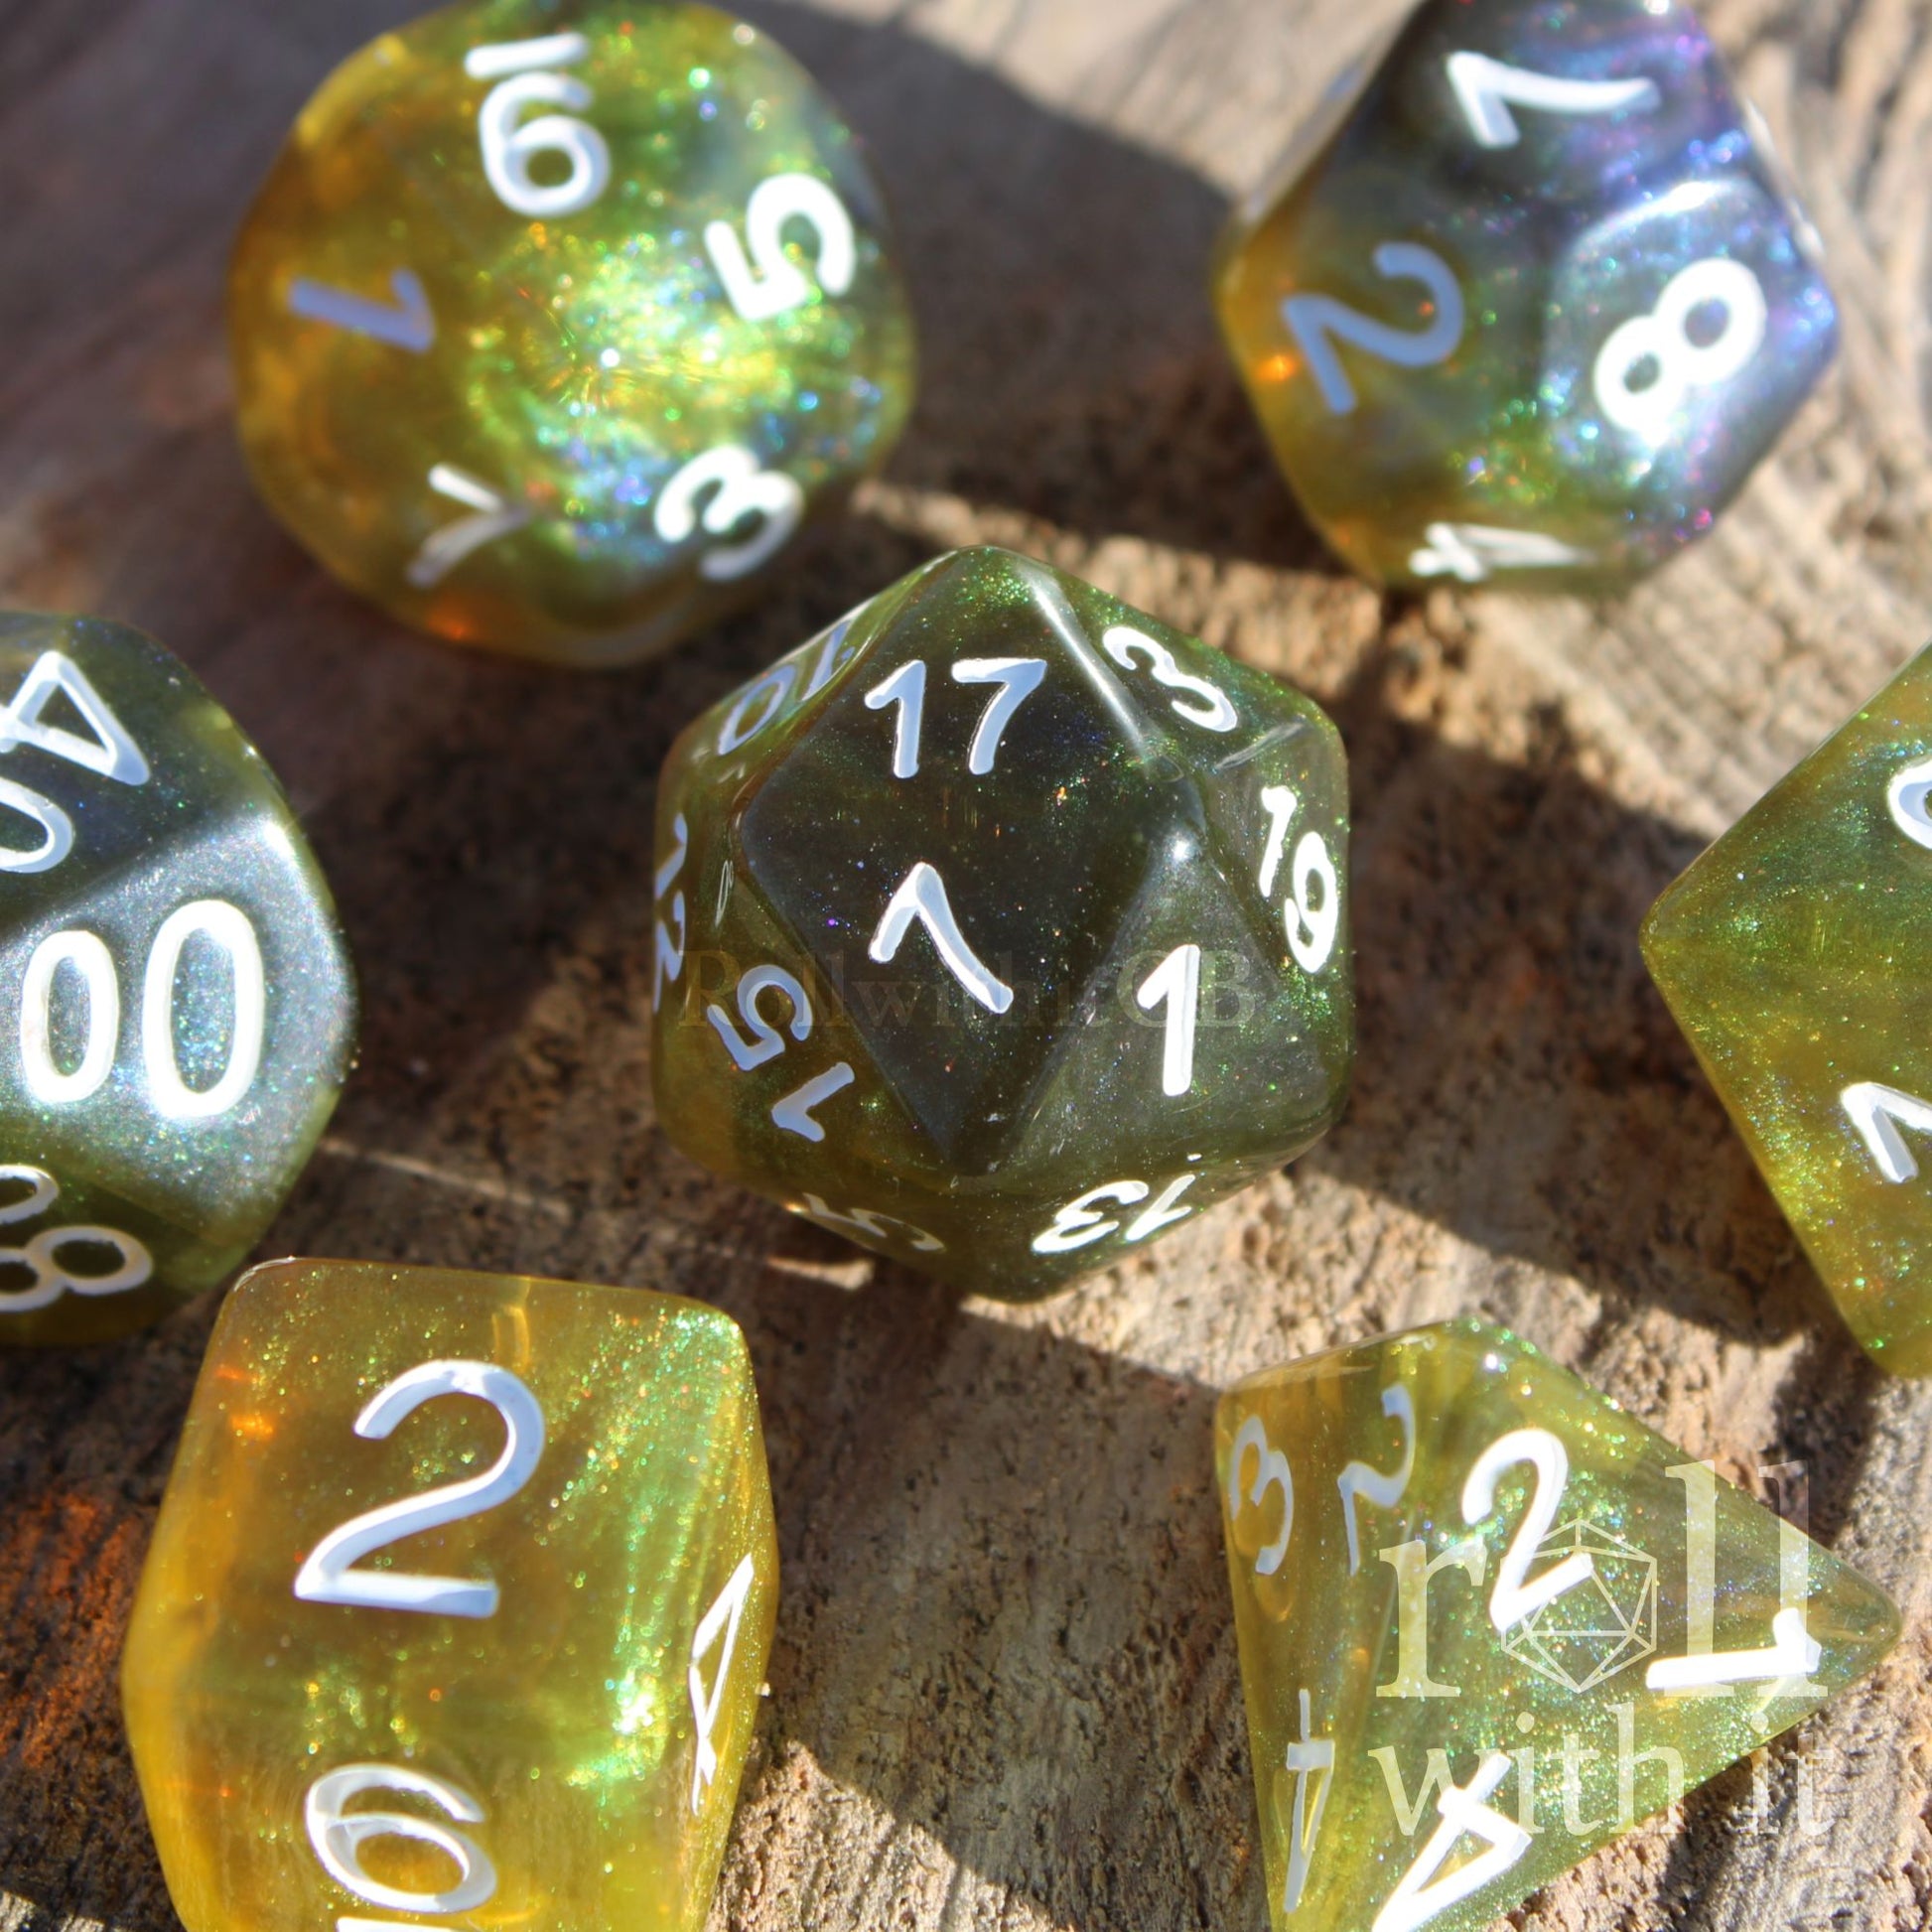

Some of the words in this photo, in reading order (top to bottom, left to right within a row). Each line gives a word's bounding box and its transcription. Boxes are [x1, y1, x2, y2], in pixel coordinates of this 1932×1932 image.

[287, 266, 436, 352] 1
[703, 171, 857, 322] 5
[1281, 242, 1464, 415] 2
[1592, 256, 1767, 447] 8
[653, 444, 805, 582] 3
[865, 658, 1048, 779] 17
[1102, 625, 1239, 734] 3
[1259, 785, 1339, 973] 19
[20, 899, 265, 1120] 00
[706, 963, 855, 1143] 15
[1137, 944, 1201, 1097] 1
[1031, 1174, 1196, 1254] 13
[294, 1358, 546, 1618] 2
[1227, 1416, 1293, 1577] 3
[1461, 1428, 1594, 1631] 2
[687, 1554, 757, 1817] 4
[1645, 1606, 1823, 1689] 1
[1283, 1688, 1335, 1914] 4
[1372, 1751, 1534, 1932] 4
